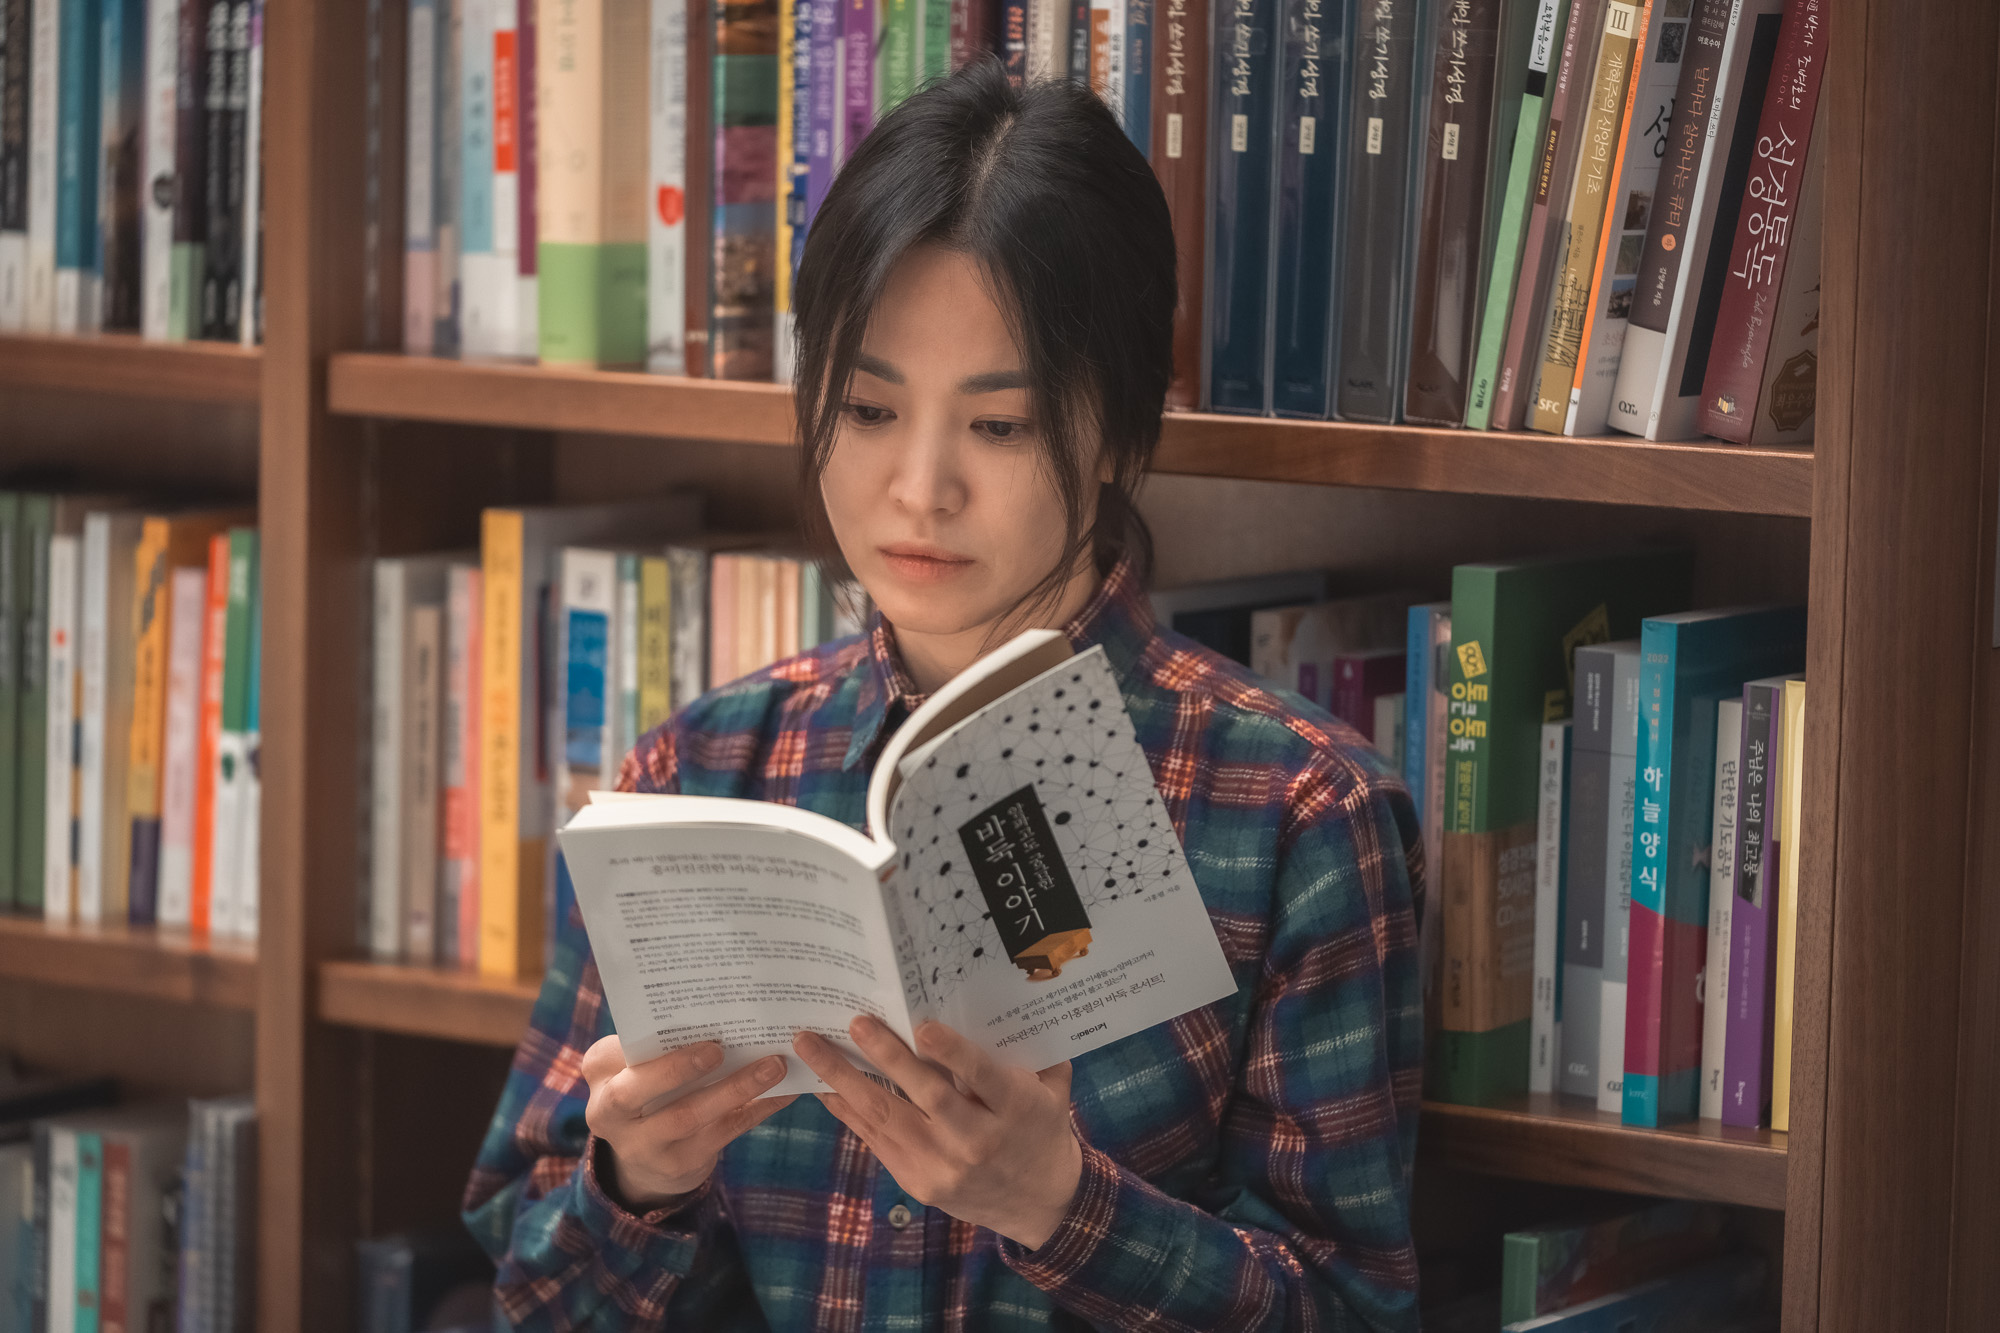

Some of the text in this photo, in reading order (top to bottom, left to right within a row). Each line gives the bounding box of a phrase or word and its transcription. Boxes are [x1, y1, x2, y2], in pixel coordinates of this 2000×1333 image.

[1697, 35, 1721, 49] 여호수아
[1598, 50, 1625, 113] 개혁주의
[1789, 55, 1812, 111] 조병호의
[1589, 113, 1613, 162] 신앙의
[1664, 64, 1711, 227] 날마다 살아나는 큐티
[1583, 162, 1604, 196] 기초
[1733, 121, 1797, 289] 성경통독
[1538, 397, 1560, 414] SFC
[1746, 739, 1764, 787] 주님은
[1638, 765, 1664, 892] 하늘양식
[1716, 759, 1737, 879] 단단한 기도공부
[1745, 792, 1762, 823] 나의
[1007, 803, 1055, 890] 알파고도 궁금한
[1743, 829, 1760, 877] 최고봉
[976, 815, 1044, 935] 바둑 이야기
[996, 973, 1166, 1049] 바둑관전기자 이홍렬의 바둑 콘서트!
[1022, 997, 1044, 1011] 그리고
[1046, 986, 1068, 1000] 세기의
[1069, 979, 1085, 991] 대결
[1031, 1006, 1046, 1017] 지금
[1047, 999, 1063, 1010] 바둑
[1087, 983, 1104, 994] 불고
[1104, 973, 1127, 988] 있는가
[1070, 1022, 1108, 1041] 더메이커
